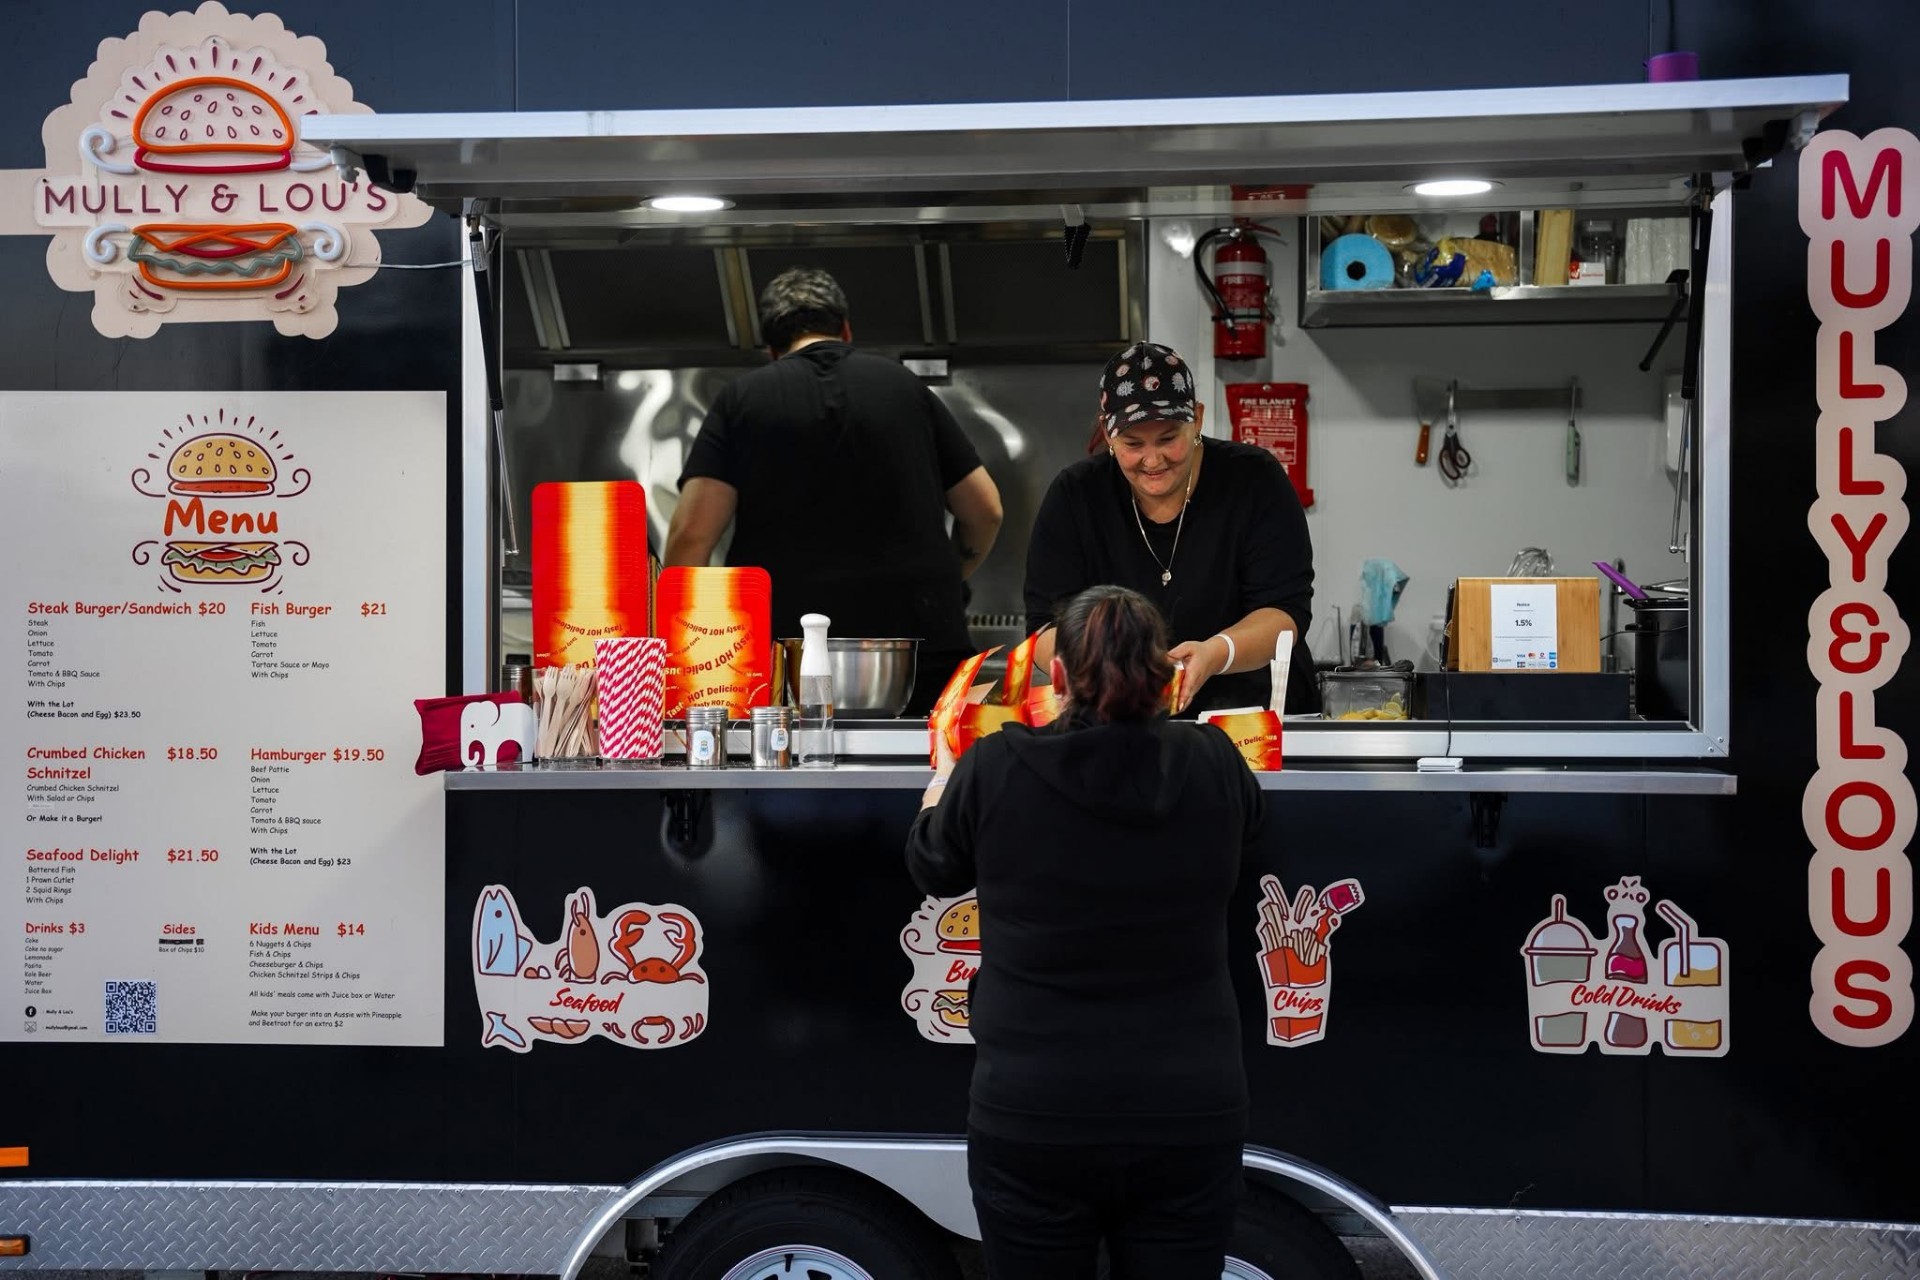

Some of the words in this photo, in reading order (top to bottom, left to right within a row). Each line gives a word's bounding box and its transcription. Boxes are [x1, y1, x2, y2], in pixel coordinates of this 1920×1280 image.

[44, 184, 189, 214] MULLY
[211, 184, 238, 212] &
[260, 182, 387, 212] LOU'S
[164, 496, 279, 536] Menu
[28, 602, 69, 614] Steak
[75, 602, 192, 618] Burger/Sandwich
[198, 602, 226, 616] $20
[251, 602, 279, 615] Fish
[286, 602, 332, 618] Burger
[361, 602, 386, 617] $21
[715, 650, 734, 668] HOT
[311, 661, 330, 670] Mayo
[62, 670, 78, 678] BBQ
[270, 671, 288, 680] Chips
[666, 700, 684, 718] Tast
[688, 689, 704, 703] HOT
[27, 710, 55, 719] (Cheese
[96, 710, 112, 720] Egg)
[27, 746, 87, 759] Crumbed
[93, 746, 145, 760] Chicken
[167, 746, 218, 762] $18.50
[251, 748, 326, 764] Hamburger
[333, 748, 384, 763] $19.50
[27, 766, 90, 779] Schnitzel
[26, 784, 57, 792] Crumbed
[76, 794, 95, 803] Chips
[284, 816, 300, 825] BBQ
[26, 848, 84, 861] Seafood
[90, 848, 139, 865] Delight
[168, 848, 219, 864] $21.50
[250, 857, 278, 866] (Cheese
[318, 858, 334, 867] Egg)
[336, 858, 351, 866] $23
[31, 876, 52, 884] Prawn
[32, 886, 52, 895] Squid
[53, 886, 72, 896] Rings
[45, 896, 64, 905] Chips
[26, 922, 64, 934] Drinks
[69, 922, 85, 935] $3
[163, 924, 196, 935] Sides
[250, 922, 278, 935] Kids
[284, 923, 319, 936] Menu
[337, 922, 365, 938] $14
[256, 940, 284, 949] Nuggets
[292, 940, 312, 949] Chips
[249, 950, 264, 958] Fish
[272, 950, 291, 959] Chips
[249, 960, 296, 970] Cheeseburger
[305, 960, 324, 970] Chips
[312, 972, 333, 980] Strips
[341, 972, 360, 980] Chips
[549, 987, 624, 1014] Seafood
[1274, 990, 1324, 1014] Chips
[1571, 984, 1619, 1006] Cold
[1616, 986, 1682, 1014] Drinks
[286, 1010, 308, 1019] burger
[372, 1011, 402, 1020] Pineapple
